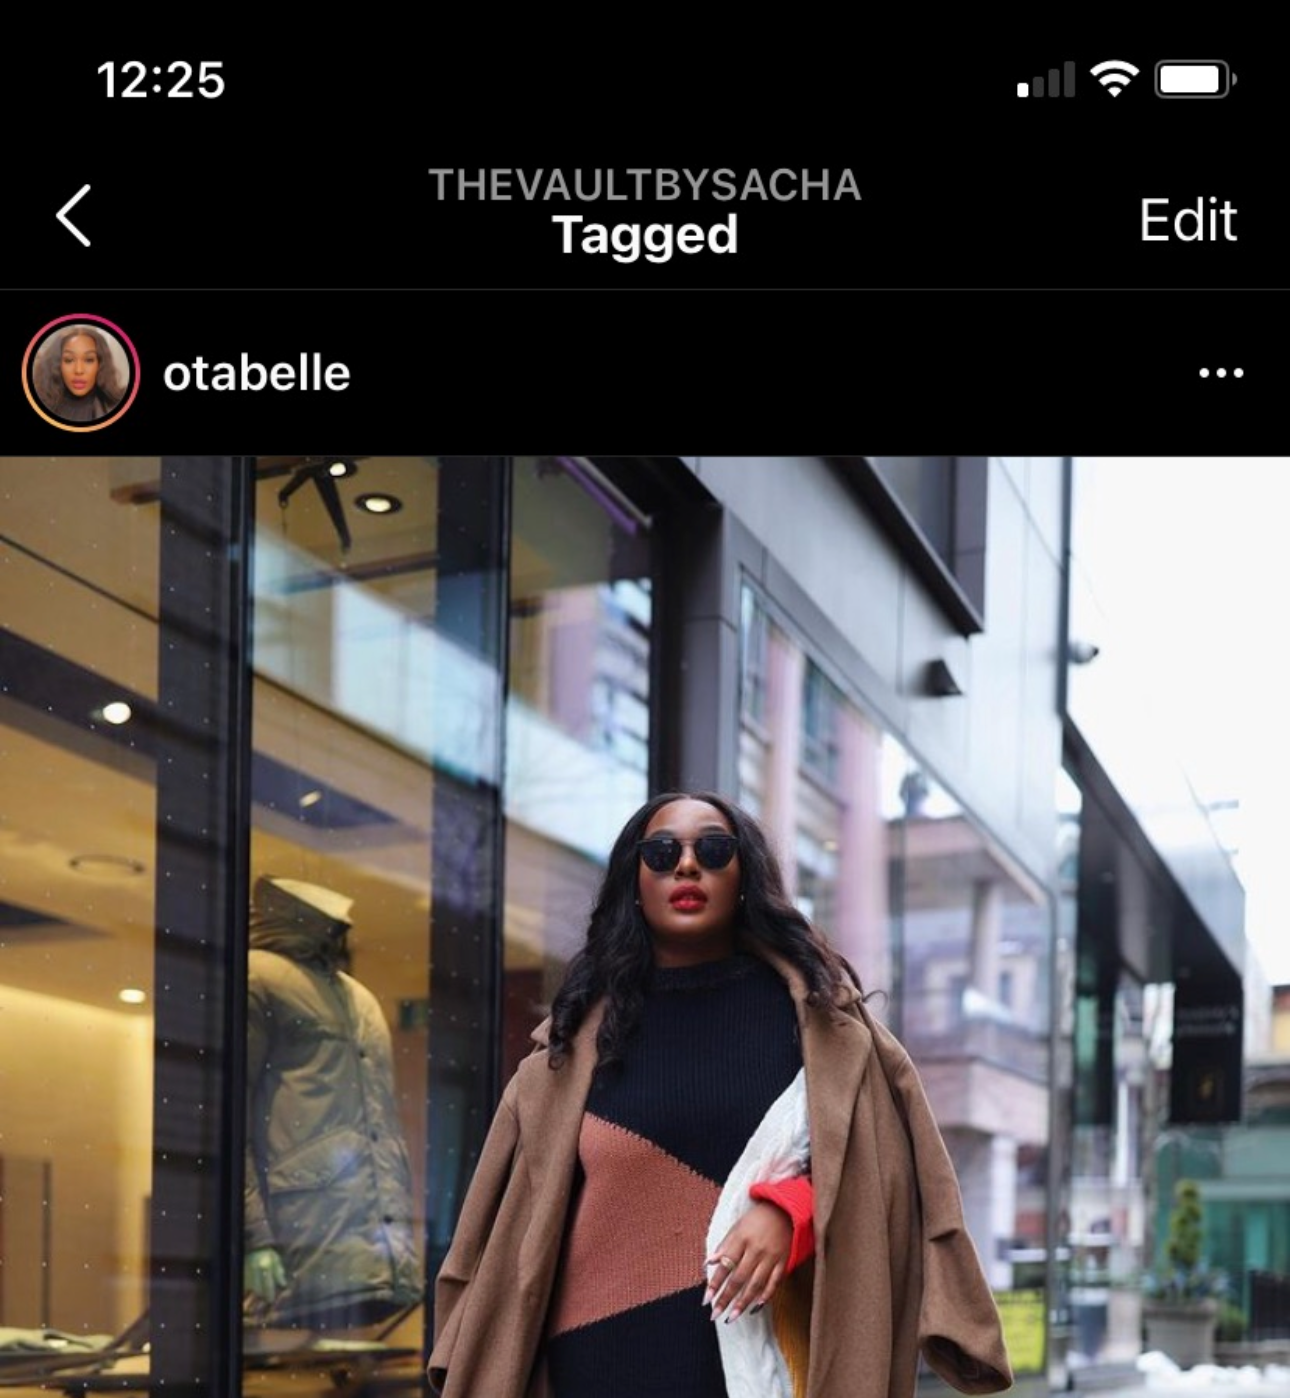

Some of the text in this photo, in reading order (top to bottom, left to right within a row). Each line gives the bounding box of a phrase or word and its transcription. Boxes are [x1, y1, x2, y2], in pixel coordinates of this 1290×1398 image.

[98, 61, 225, 99] 12:25
[428, 168, 862, 201] THEVAULTBYSACHA
[551, 213, 737, 264] Tagged
[1142, 196, 1237, 242] Edit
[163, 352, 350, 391] otabelle
